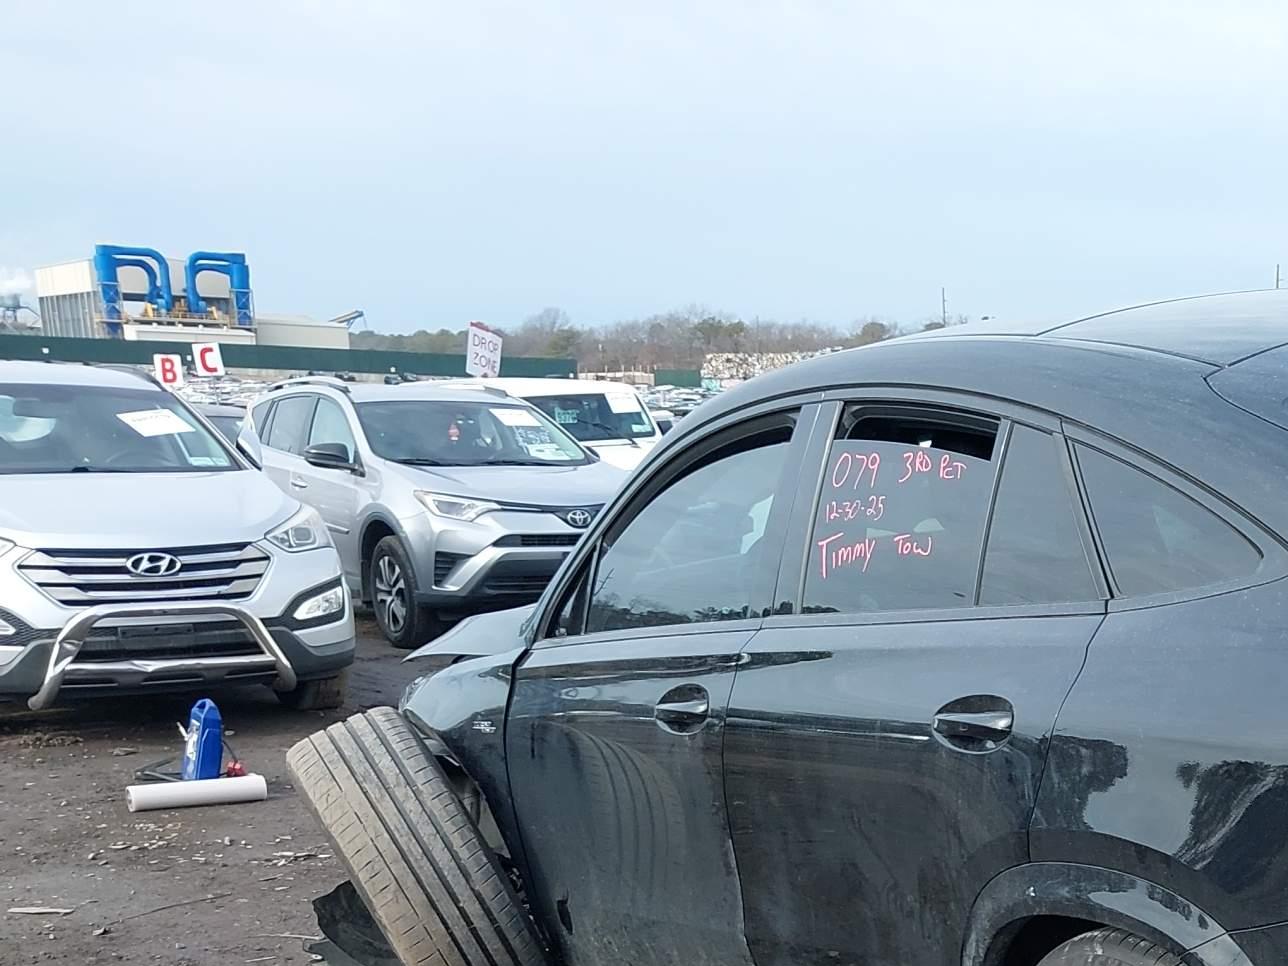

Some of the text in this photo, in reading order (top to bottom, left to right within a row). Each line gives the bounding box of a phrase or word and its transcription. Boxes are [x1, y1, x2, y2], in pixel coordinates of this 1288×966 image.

[472, 333, 499, 352] DROP
[161, 358, 177, 384] B
[200, 347, 218, 373] C
[473, 351, 498, 374] ZONE
[832, 452, 881, 490] 079
[898, 451, 932, 483] 3RD
